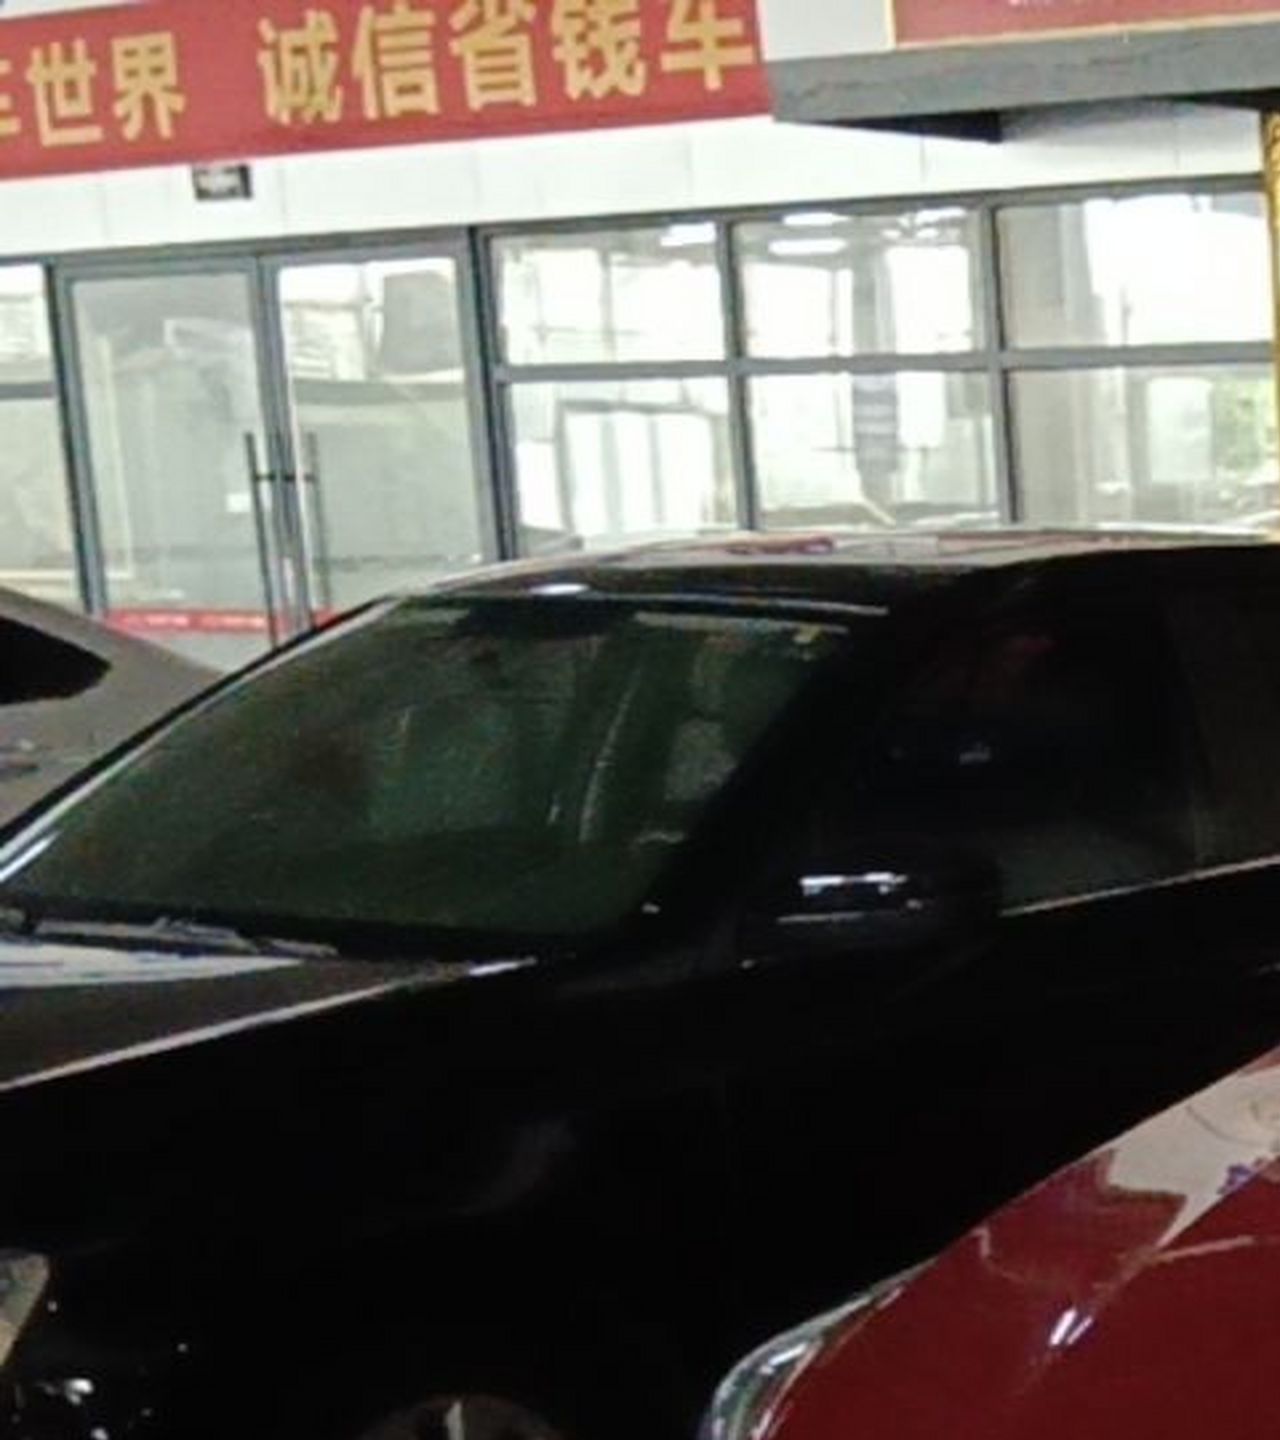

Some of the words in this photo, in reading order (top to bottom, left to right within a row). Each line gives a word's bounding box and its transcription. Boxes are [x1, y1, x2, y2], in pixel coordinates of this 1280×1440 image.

[0, 32, 186, 147] 世界
[257, 0, 754, 126] 诚信省钱车
